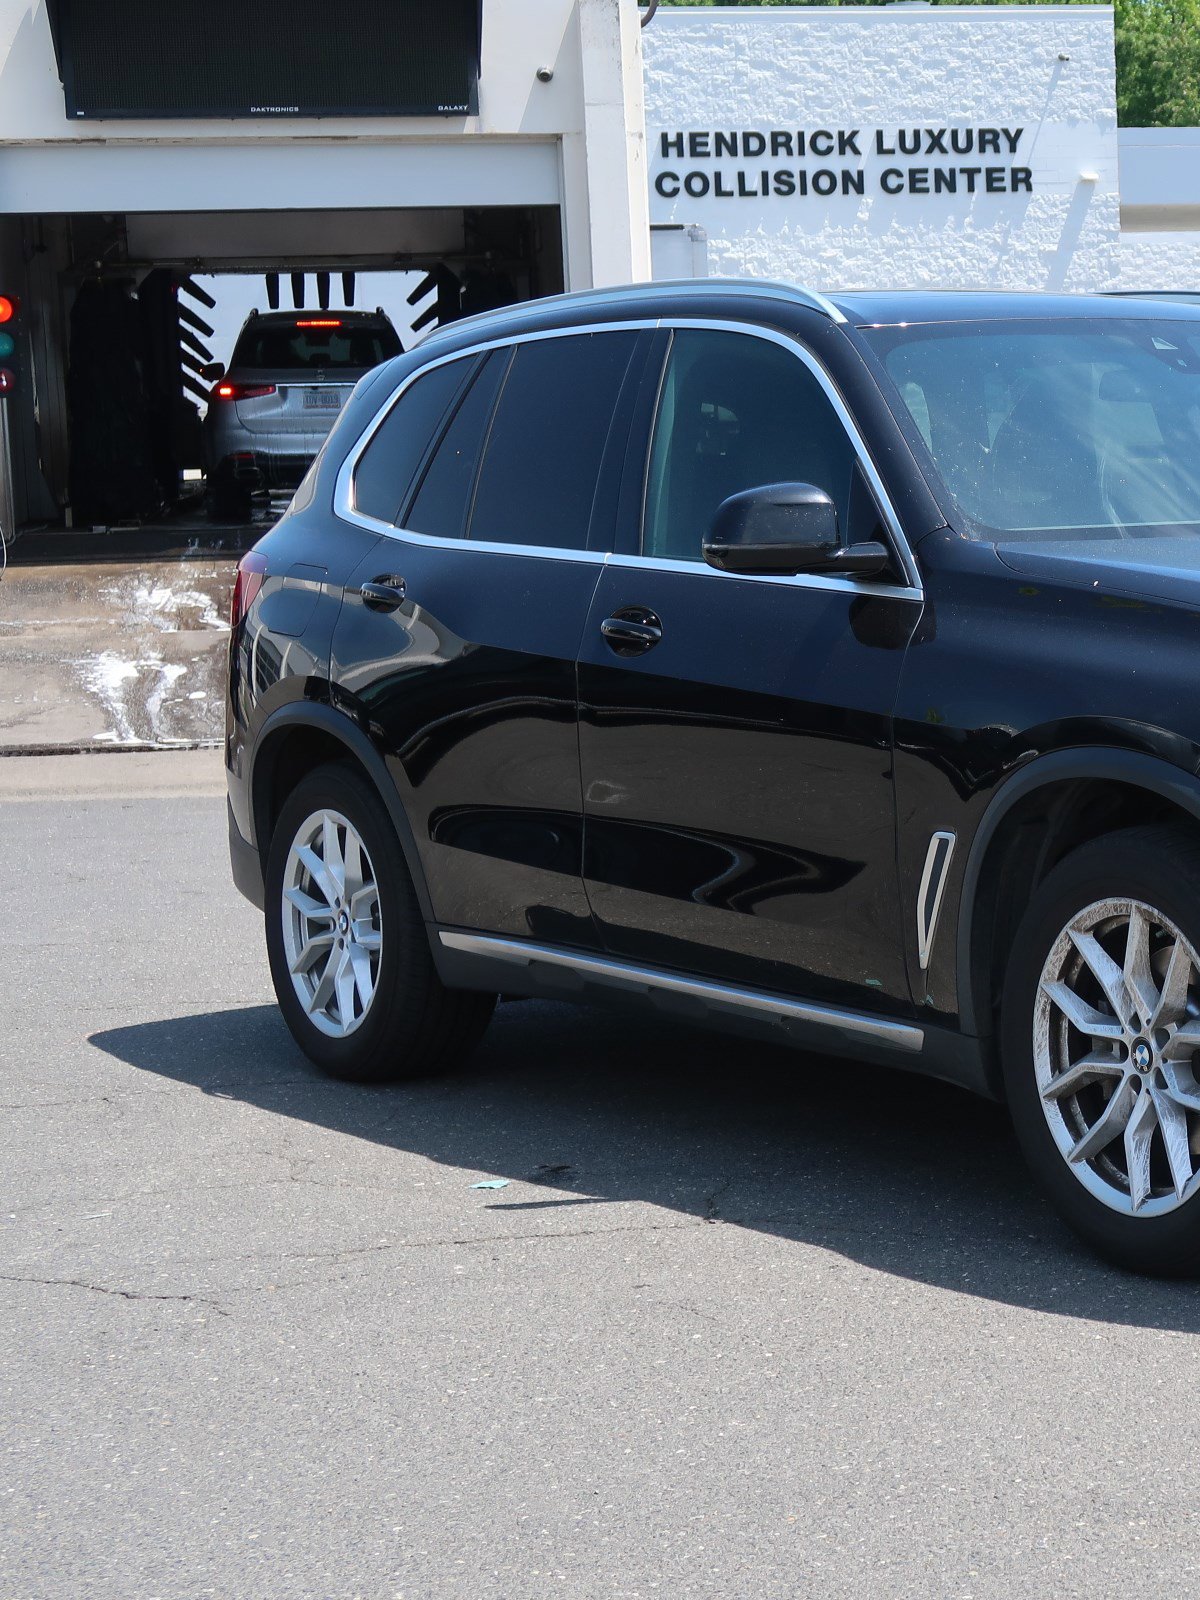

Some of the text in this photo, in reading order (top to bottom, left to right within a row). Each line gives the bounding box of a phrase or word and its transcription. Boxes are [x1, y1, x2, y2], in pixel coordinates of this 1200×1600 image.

[660, 128, 1024, 159] HENDRICK LUXURY
[654, 166, 1033, 199] COLLISION CENTER
